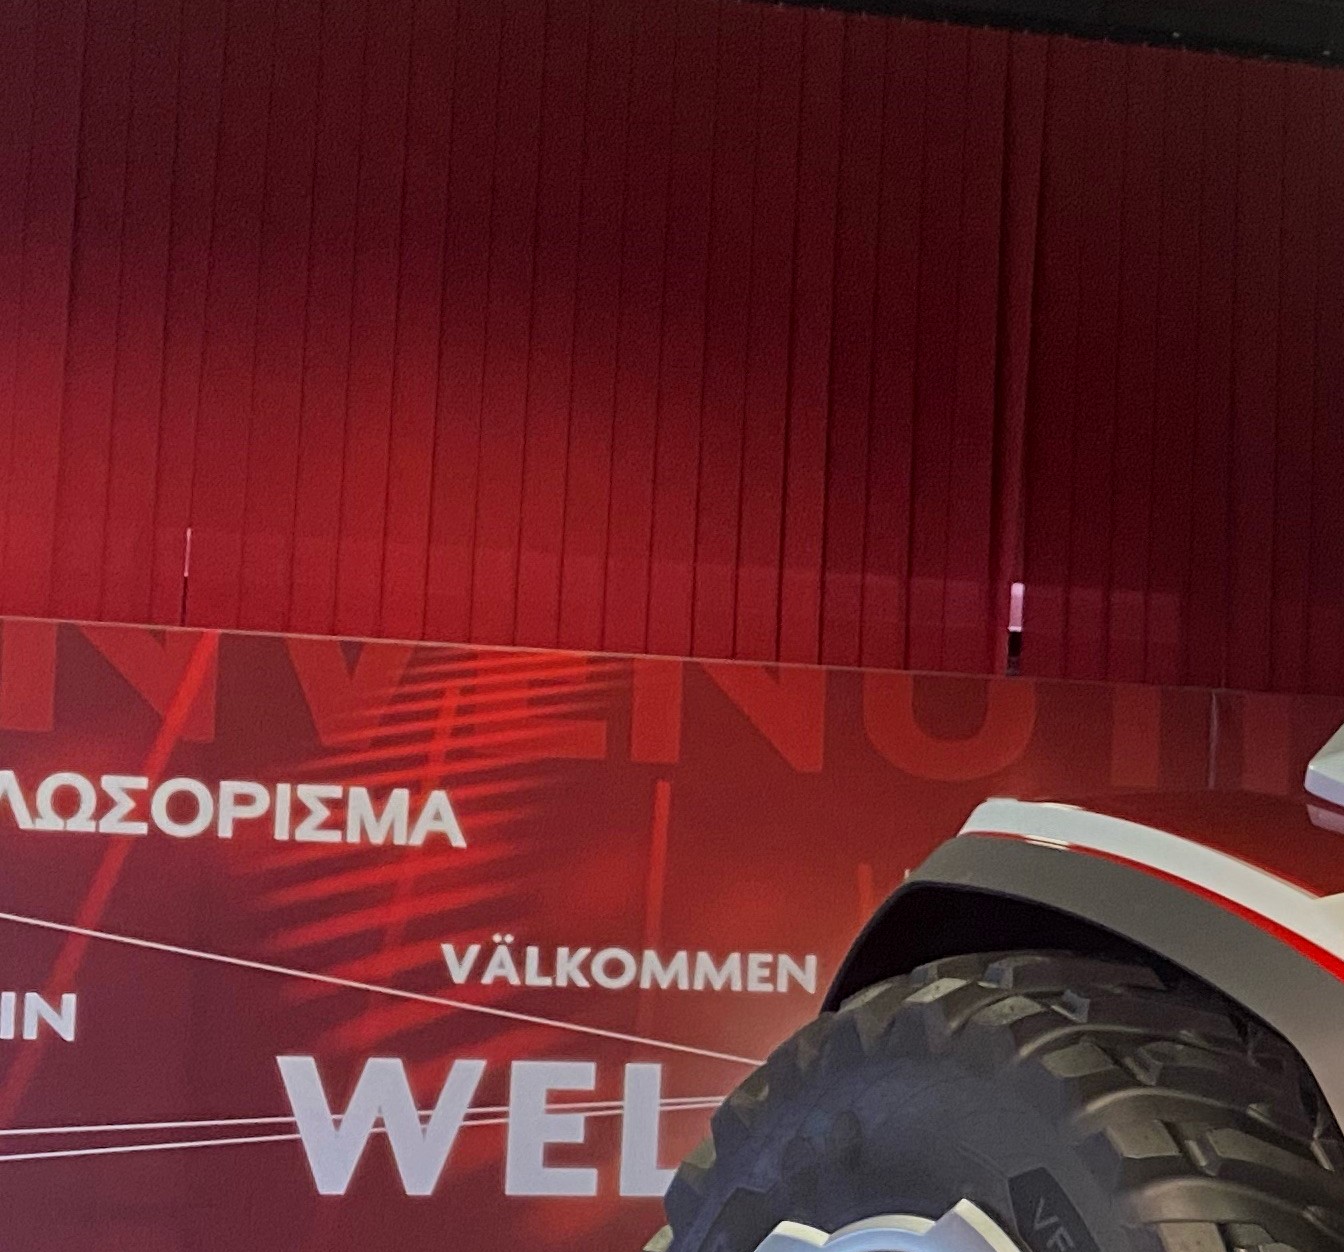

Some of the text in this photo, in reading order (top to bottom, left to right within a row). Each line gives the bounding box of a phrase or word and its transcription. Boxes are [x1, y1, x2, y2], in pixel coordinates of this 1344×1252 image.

[441, 933, 818, 994] VÄLKOMMEN
[0, 991, 77, 1042] IN
[276, 1055, 678, 1198] WEL
